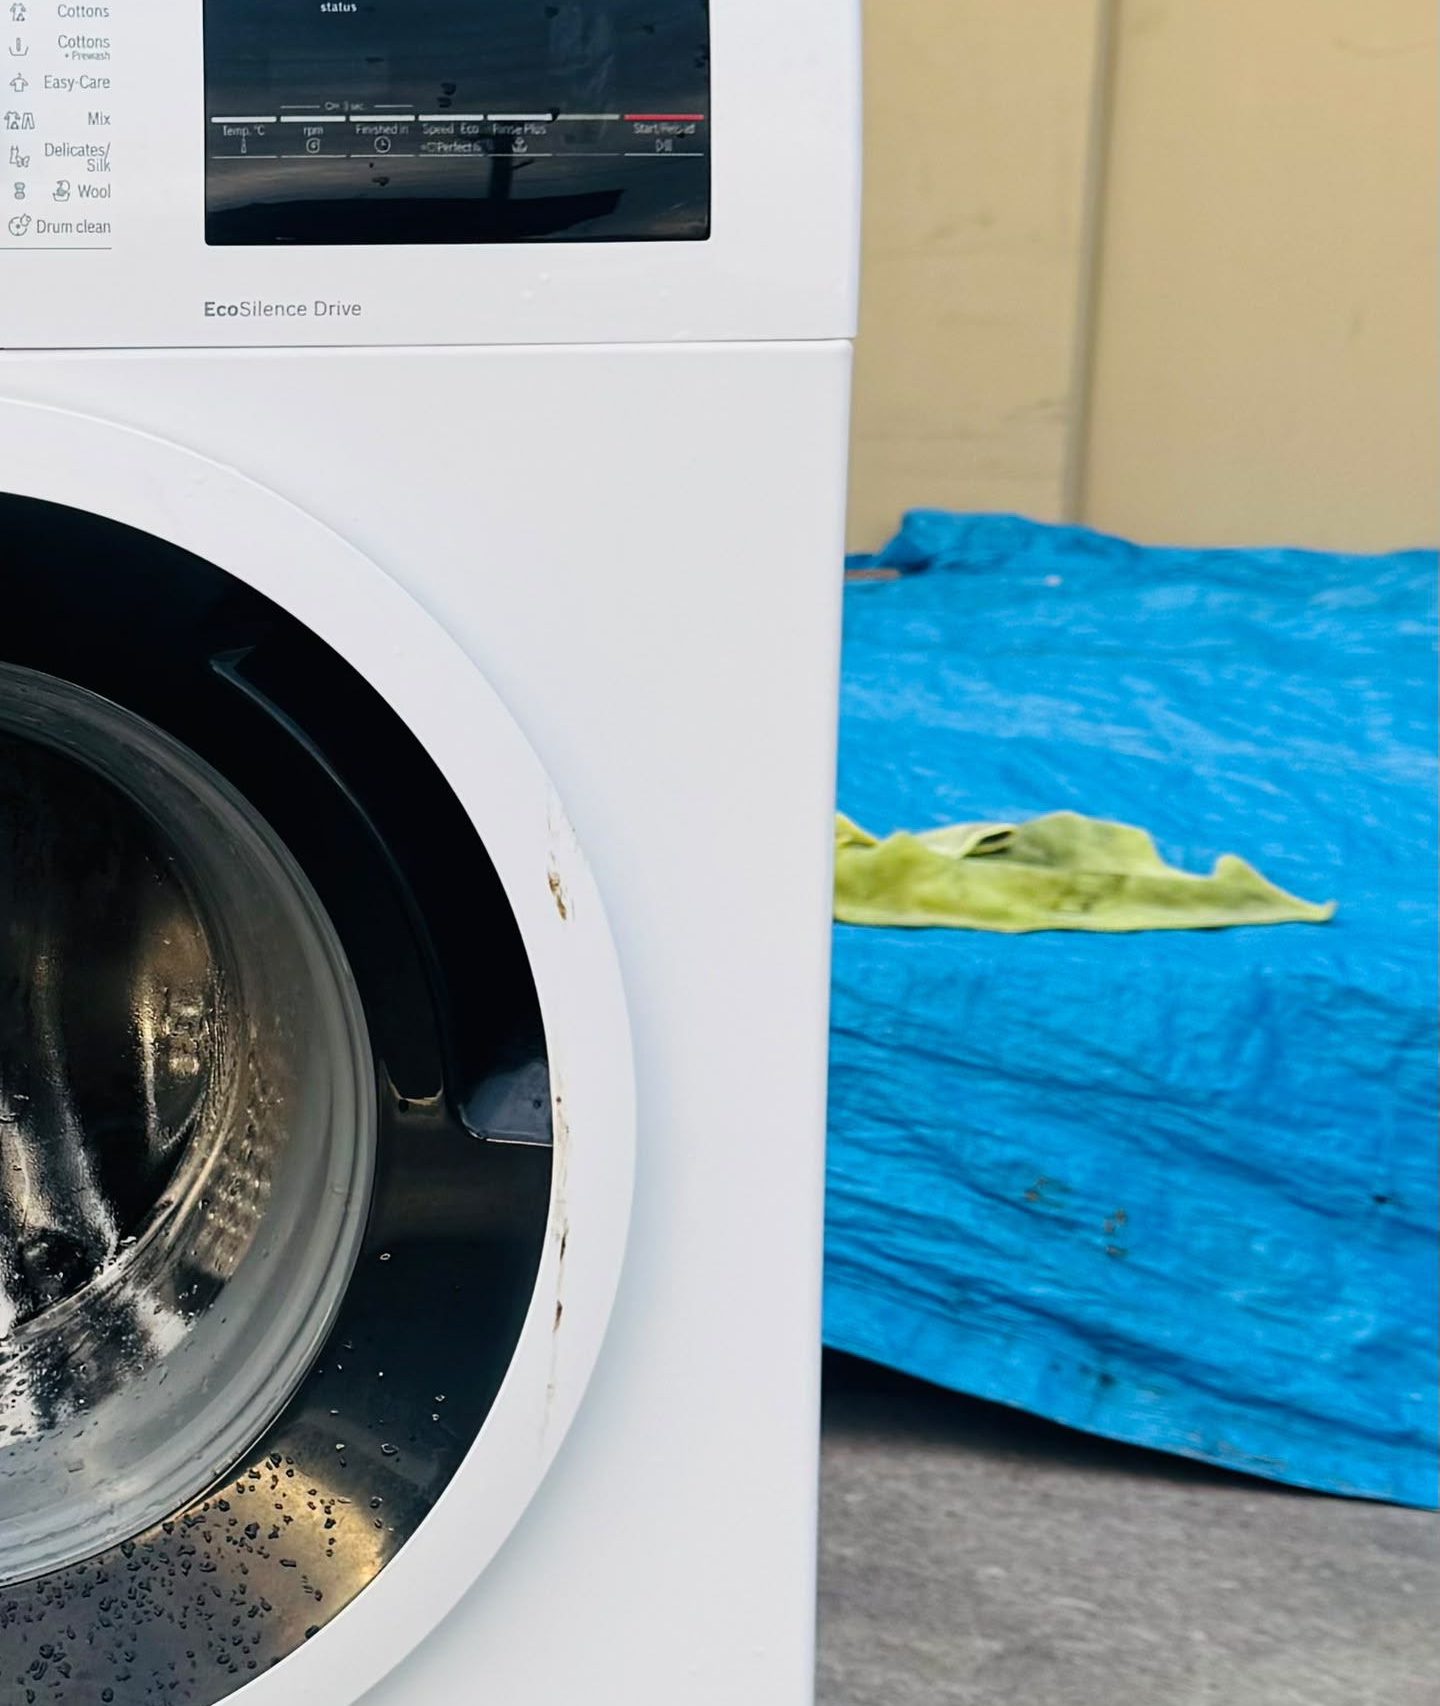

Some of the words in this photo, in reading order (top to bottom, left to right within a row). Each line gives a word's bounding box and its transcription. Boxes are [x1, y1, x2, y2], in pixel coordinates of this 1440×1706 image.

[57, 4, 110, 18] Cottons
[58, 34, 110, 49] Cottons
[44, 75, 110, 92] Easy-Care
[88, 112, 111, 126] Mix
[303, 126, 324, 138] rpm
[44, 142, 111, 159] Delicates/
[87, 158, 112, 173] Silk
[77, 184, 111, 199] Wool
[36, 219, 73, 235] Drum
[76, 219, 111, 235] clean
[203, 300, 308, 318] EcoSilence
[313, 300, 362, 318] Drive
